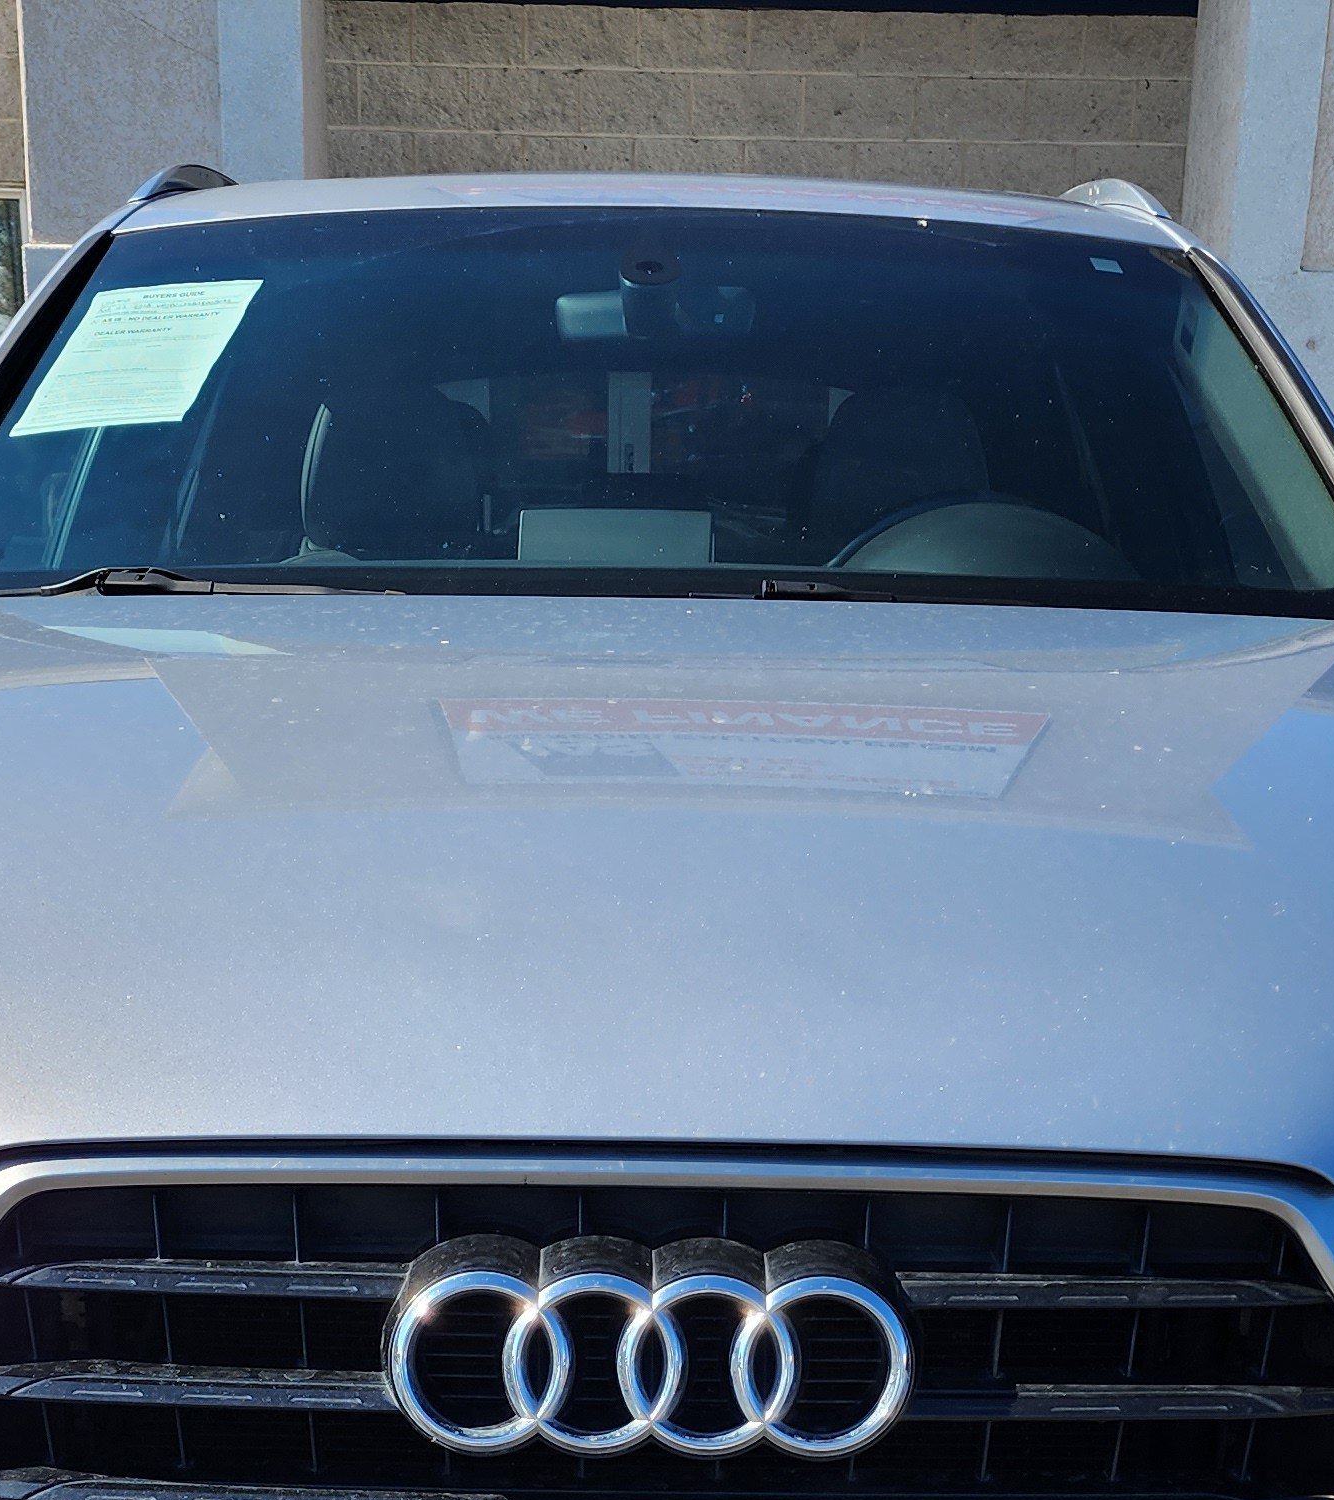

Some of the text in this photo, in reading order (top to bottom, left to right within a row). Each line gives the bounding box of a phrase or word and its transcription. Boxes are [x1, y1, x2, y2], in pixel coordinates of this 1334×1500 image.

[179, 290, 206, 298] GUIDE
[141, 314, 176, 322] DEALER
[175, 311, 221, 320] WARRANTY
[93, 326, 173, 336] DEALER WARRANTY
